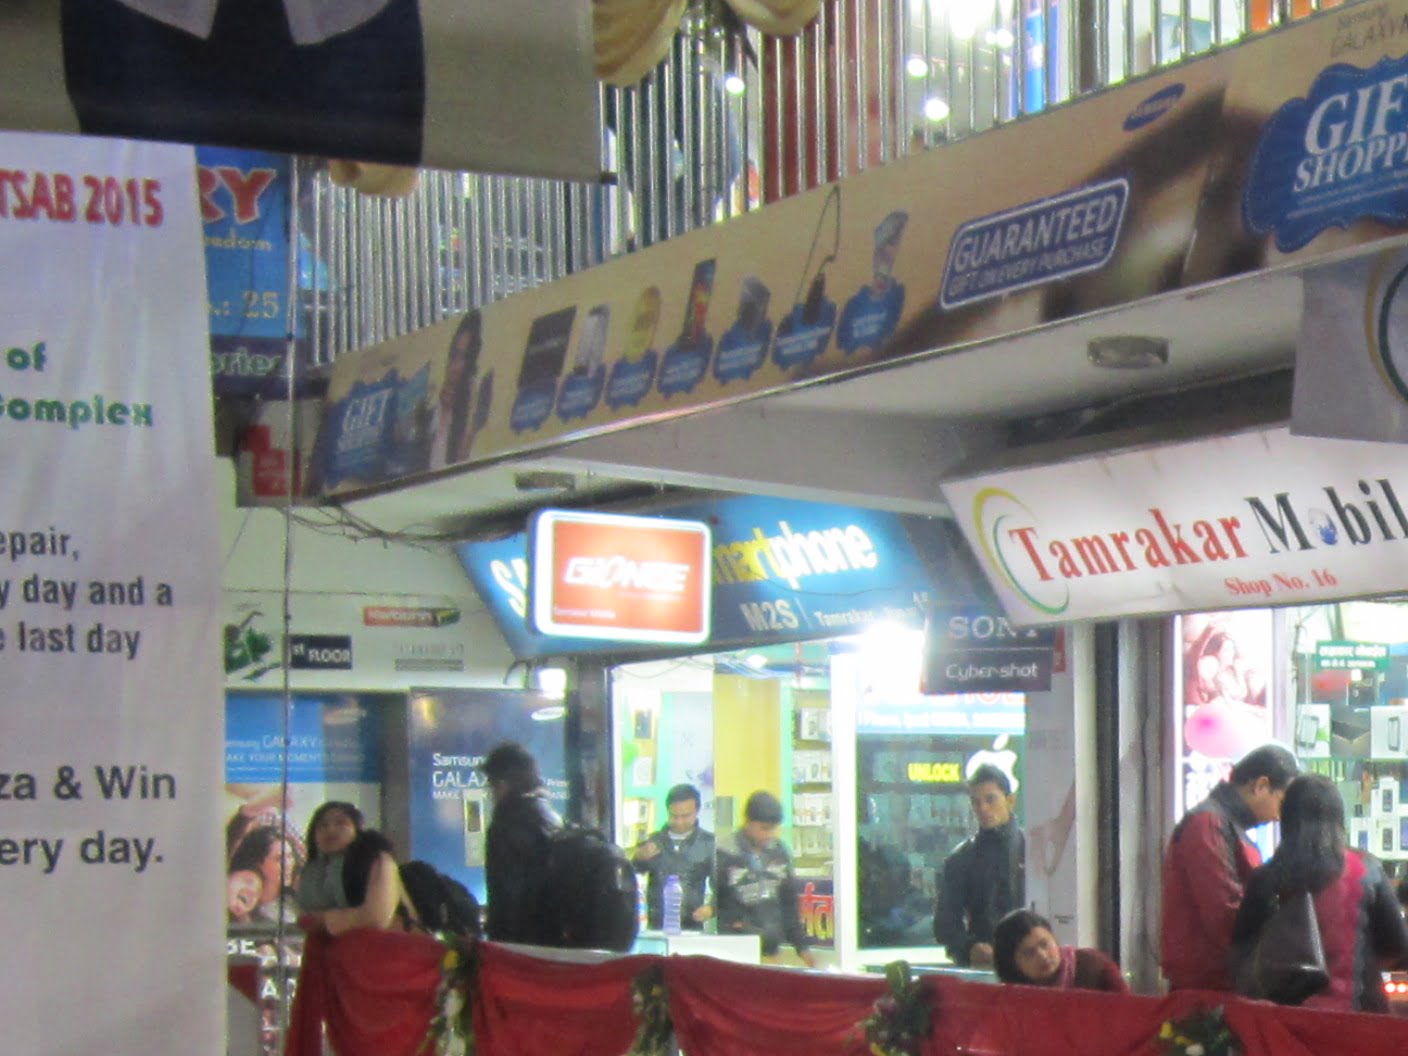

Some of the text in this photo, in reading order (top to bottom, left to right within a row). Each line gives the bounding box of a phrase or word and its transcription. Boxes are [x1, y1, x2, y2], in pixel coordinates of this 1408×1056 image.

[83, 174, 163, 227] 2015
[953, 194, 1118, 273] GUARANTEED
[1037, 235, 1109, 272] PURCHASE
[242, 291, 279, 319] 25
[5, 341, 46, 371] of
[0, 393, 153, 430] omplex
[713, 518, 879, 590] martphone
[1008, 506, 1251, 583] Tamrakar
[22, 572, 77, 611] day
[88, 575, 145, 606] and
[155, 582, 173, 607] a
[1223, 566, 1340, 599] Shop No. 16
[18, 621, 141, 661] last day
[308, 649, 350, 664] FLOOR
[432, 752, 486, 768] Samsun
[907, 762, 961, 783] UNLOCK
[54, 765, 83, 800] &
[94, 765, 176, 800] Win
[0, 830, 163, 875] ery day.
